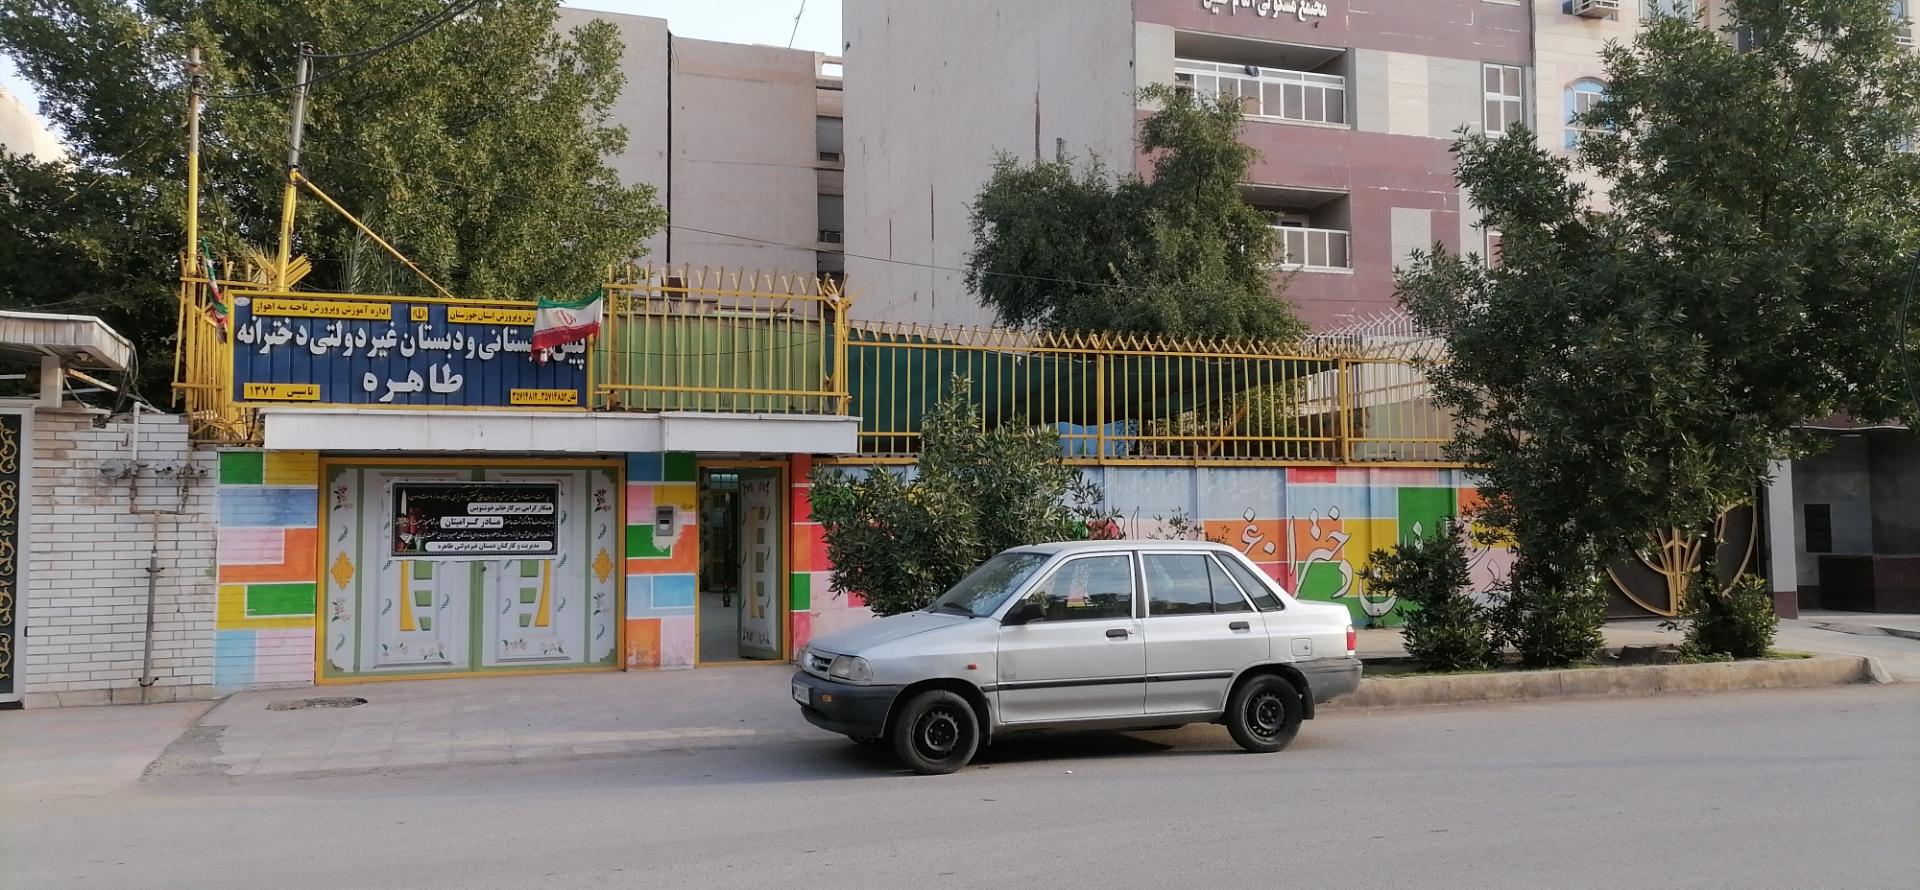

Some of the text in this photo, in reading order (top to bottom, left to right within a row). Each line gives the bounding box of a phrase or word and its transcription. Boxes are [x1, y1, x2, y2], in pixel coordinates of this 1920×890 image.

[255, 302, 275, 312] اهواز
[289, 303, 308, 311] ناحیه
[341, 305, 368, 316] آموزش
[370, 307, 389, 317] اداره
[450, 310, 477, 320] خوزستان
[478, 311, 495, 321] استان
[237, 315, 308, 354] دخترانه
[400, 323, 463, 359] دبستان
[478, 326, 553, 362] بستانی
[363, 363, 464, 402] طاهره
[249, 386, 314, 397] تاسیس ۱۳۷۲
[481, 517, 501, 528] مادر
